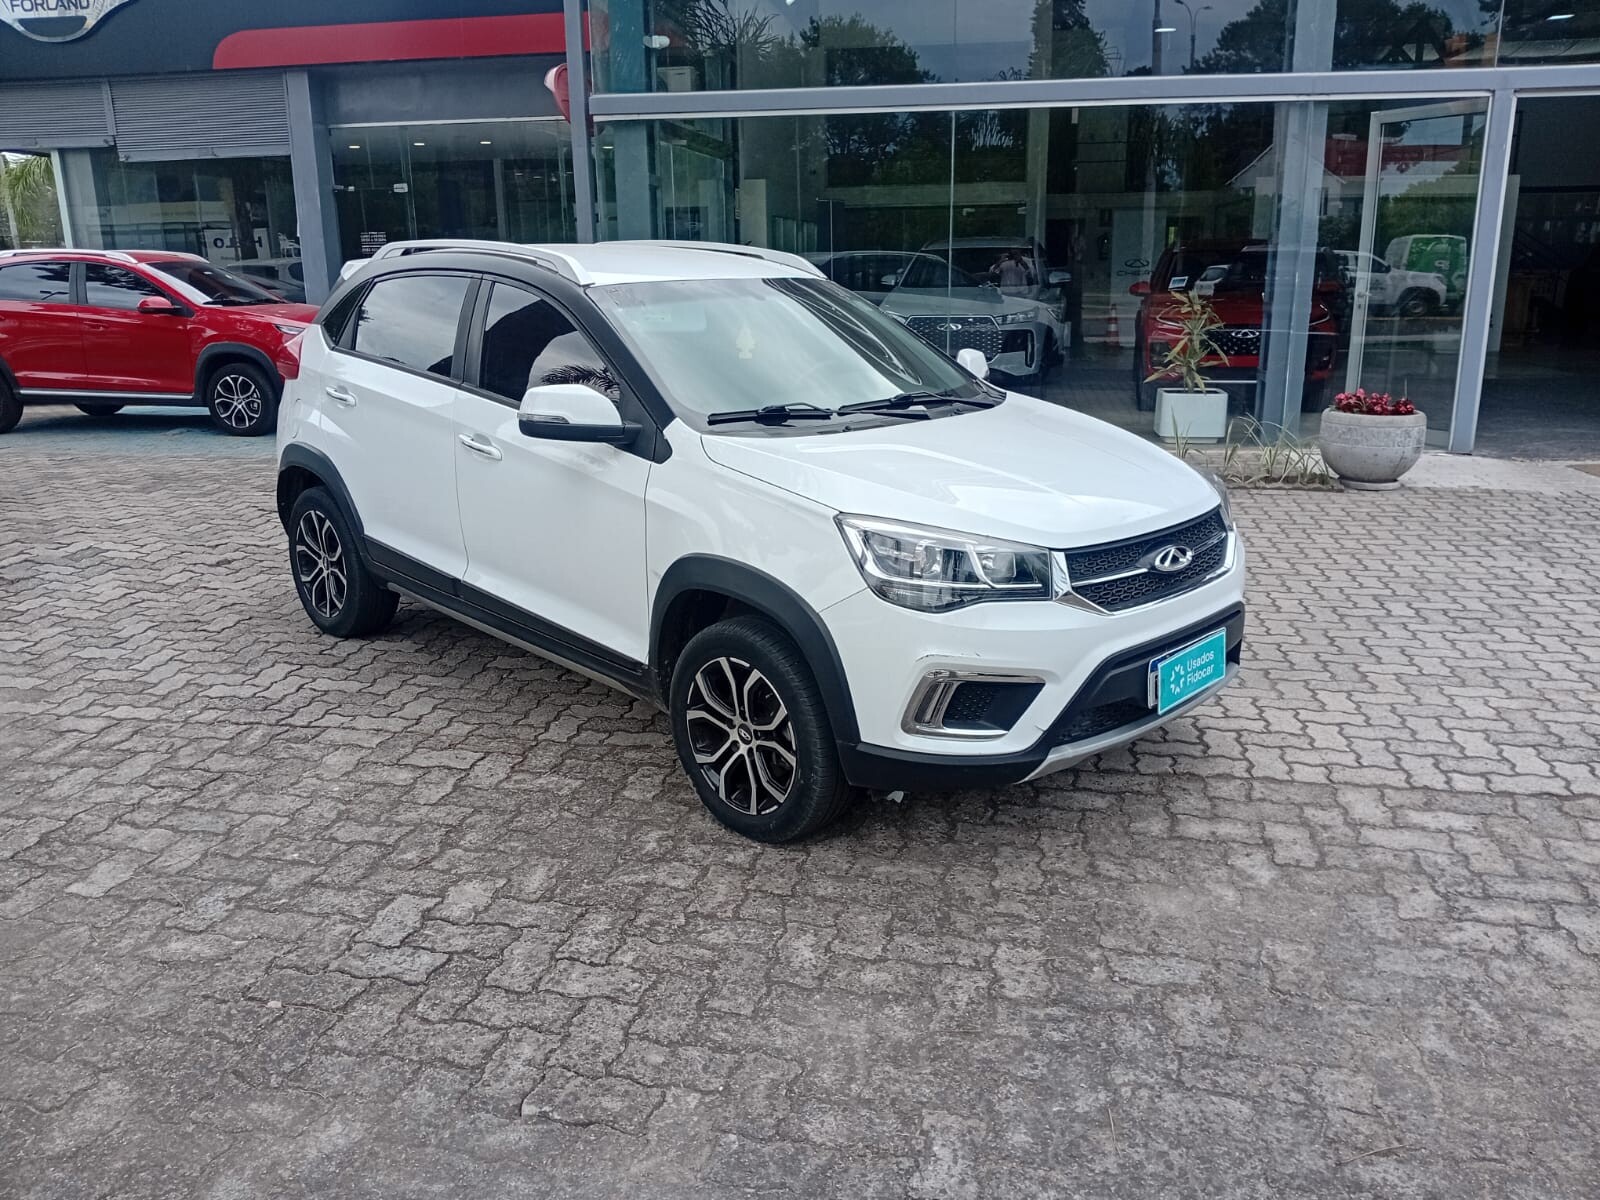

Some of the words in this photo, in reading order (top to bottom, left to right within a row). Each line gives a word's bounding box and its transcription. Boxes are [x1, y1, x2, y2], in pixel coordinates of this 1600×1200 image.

[10, 0, 90, 12] FORLAND
[1187, 650, 1215, 672] Usados
[1187, 664, 1215, 686] Fidocar
